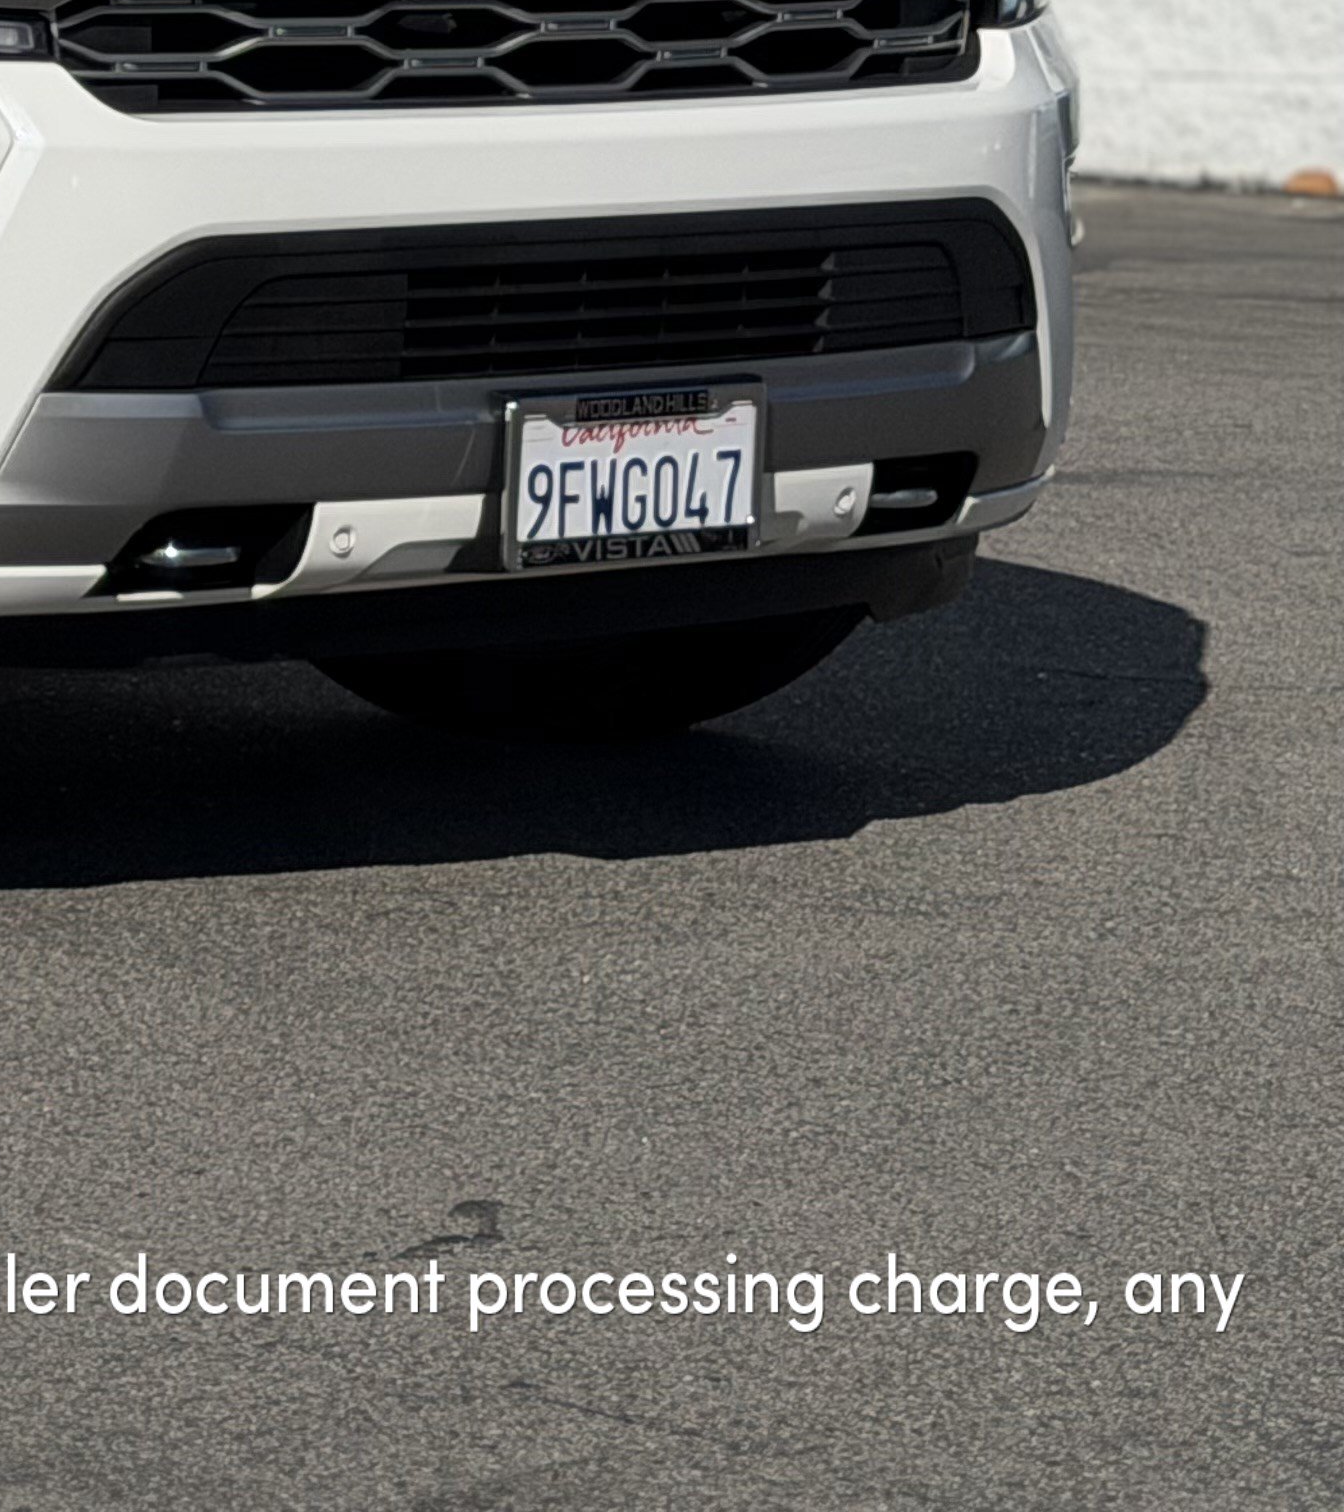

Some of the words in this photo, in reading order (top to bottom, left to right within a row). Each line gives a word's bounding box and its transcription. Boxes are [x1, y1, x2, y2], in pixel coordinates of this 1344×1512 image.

[578, 394, 661, 420] WOODLAND
[664, 390, 708, 413] HILLS
[526, 448, 742, 540] 9FWG047
[571, 533, 673, 562] VISTA
